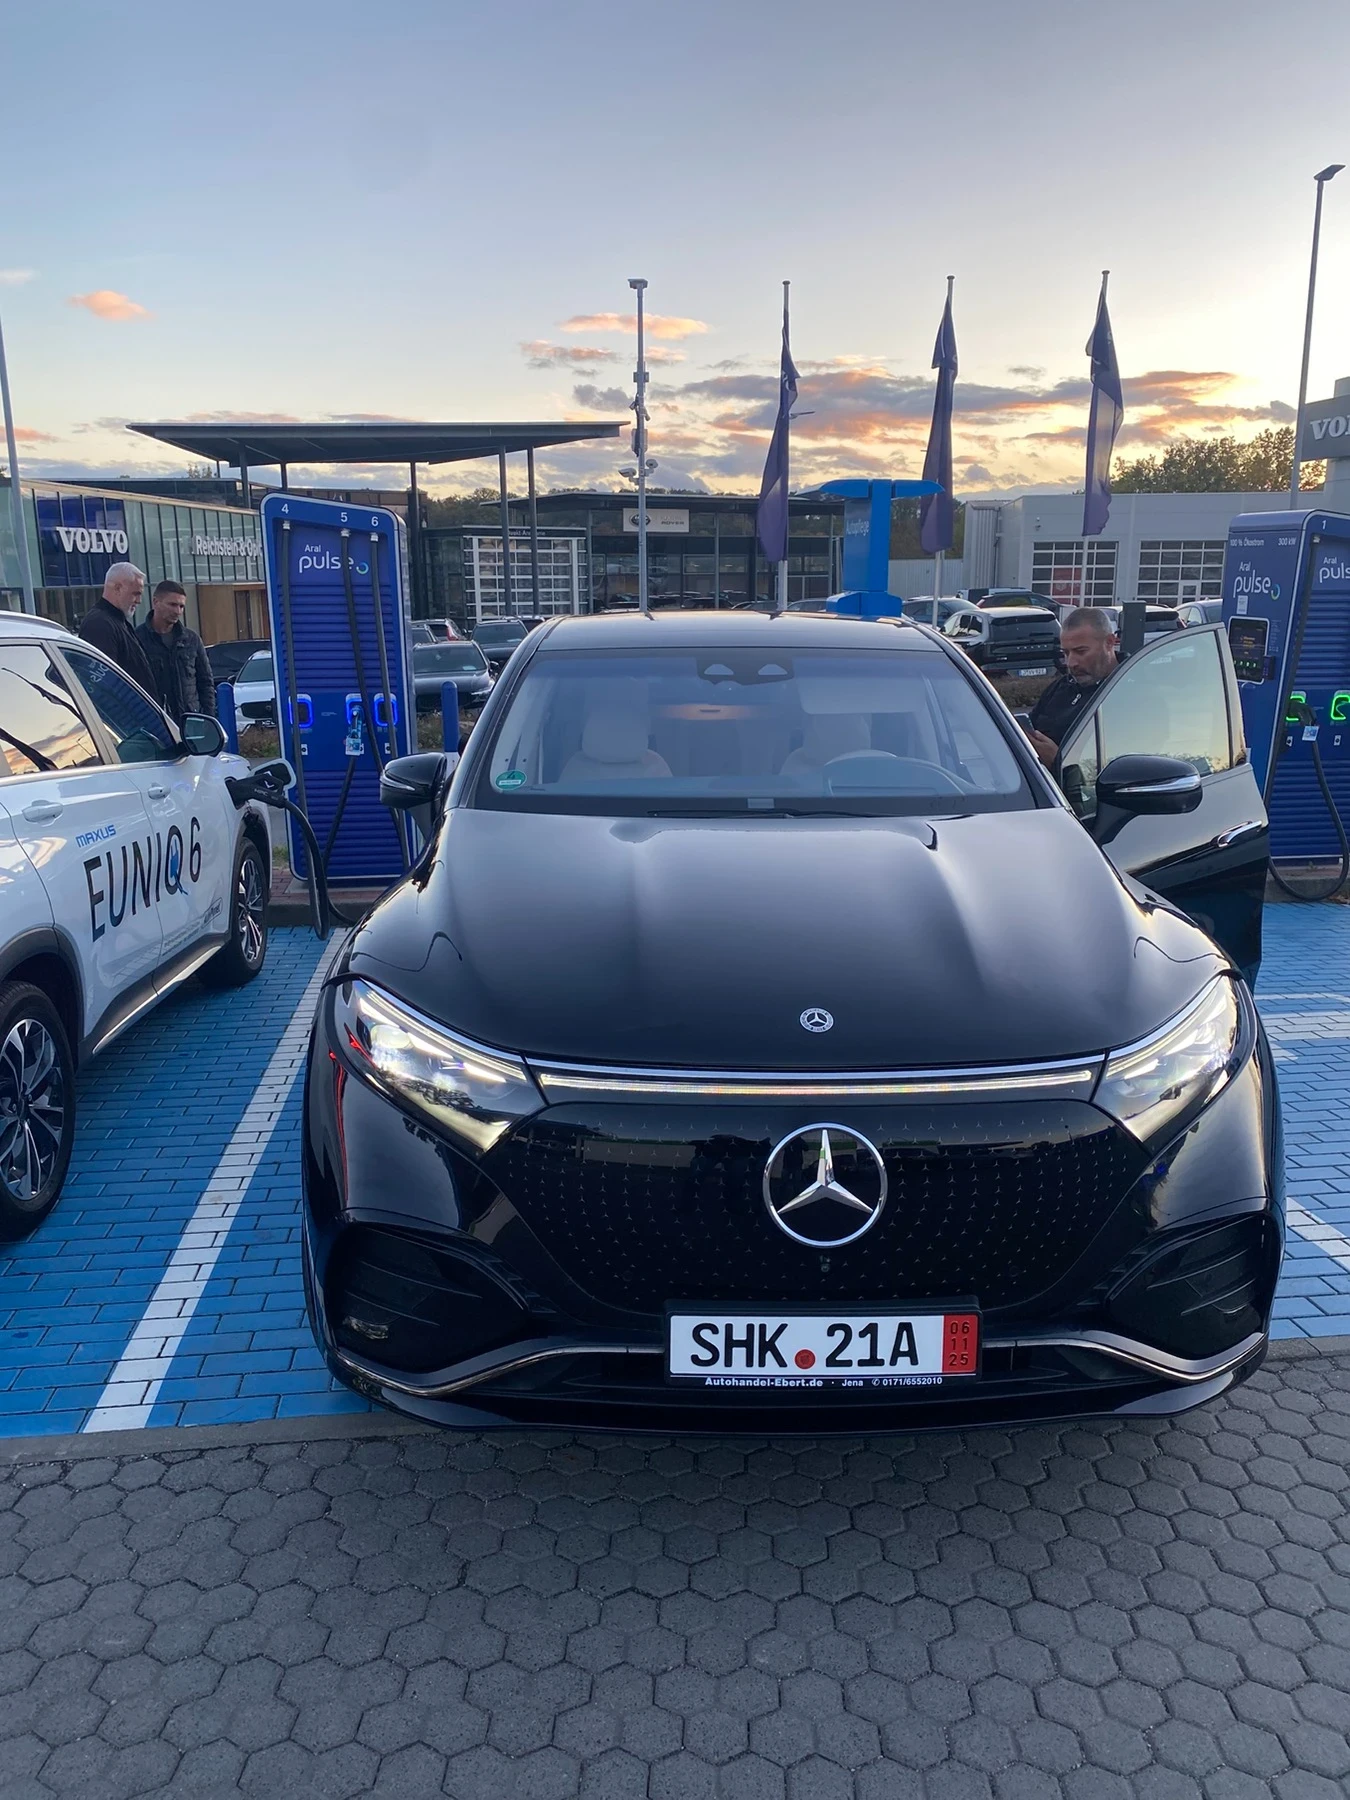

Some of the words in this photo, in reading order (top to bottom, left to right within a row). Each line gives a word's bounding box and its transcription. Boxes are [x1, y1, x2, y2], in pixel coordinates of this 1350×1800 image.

[281, 503, 289, 514] 4
[340, 512, 348, 522] 5
[371, 516, 379, 527] 6
[1322, 520, 1327, 529] 1
[56, 527, 129, 554] VOLVO
[304, 544, 321, 553] Aral
[1239, 561, 1251, 571] Aral
[1323, 557, 1337, 565] Aral
[1233, 569, 1271, 598] pulse
[75, 824, 117, 848] MAXUS
[950, 1321, 970, 1335] 06
[691, 1323, 788, 1368] SHK
[825, 1322, 919, 1367] 21A
[951, 1337, 969, 1350] 11
[949, 1352, 969, 1367] 25
[705, 1377, 823, 1387] Autohandel-Ebert.de
[841, 1378, 863, 1387] Jena
[882, 1377, 943, 1386] 0171/6552010
